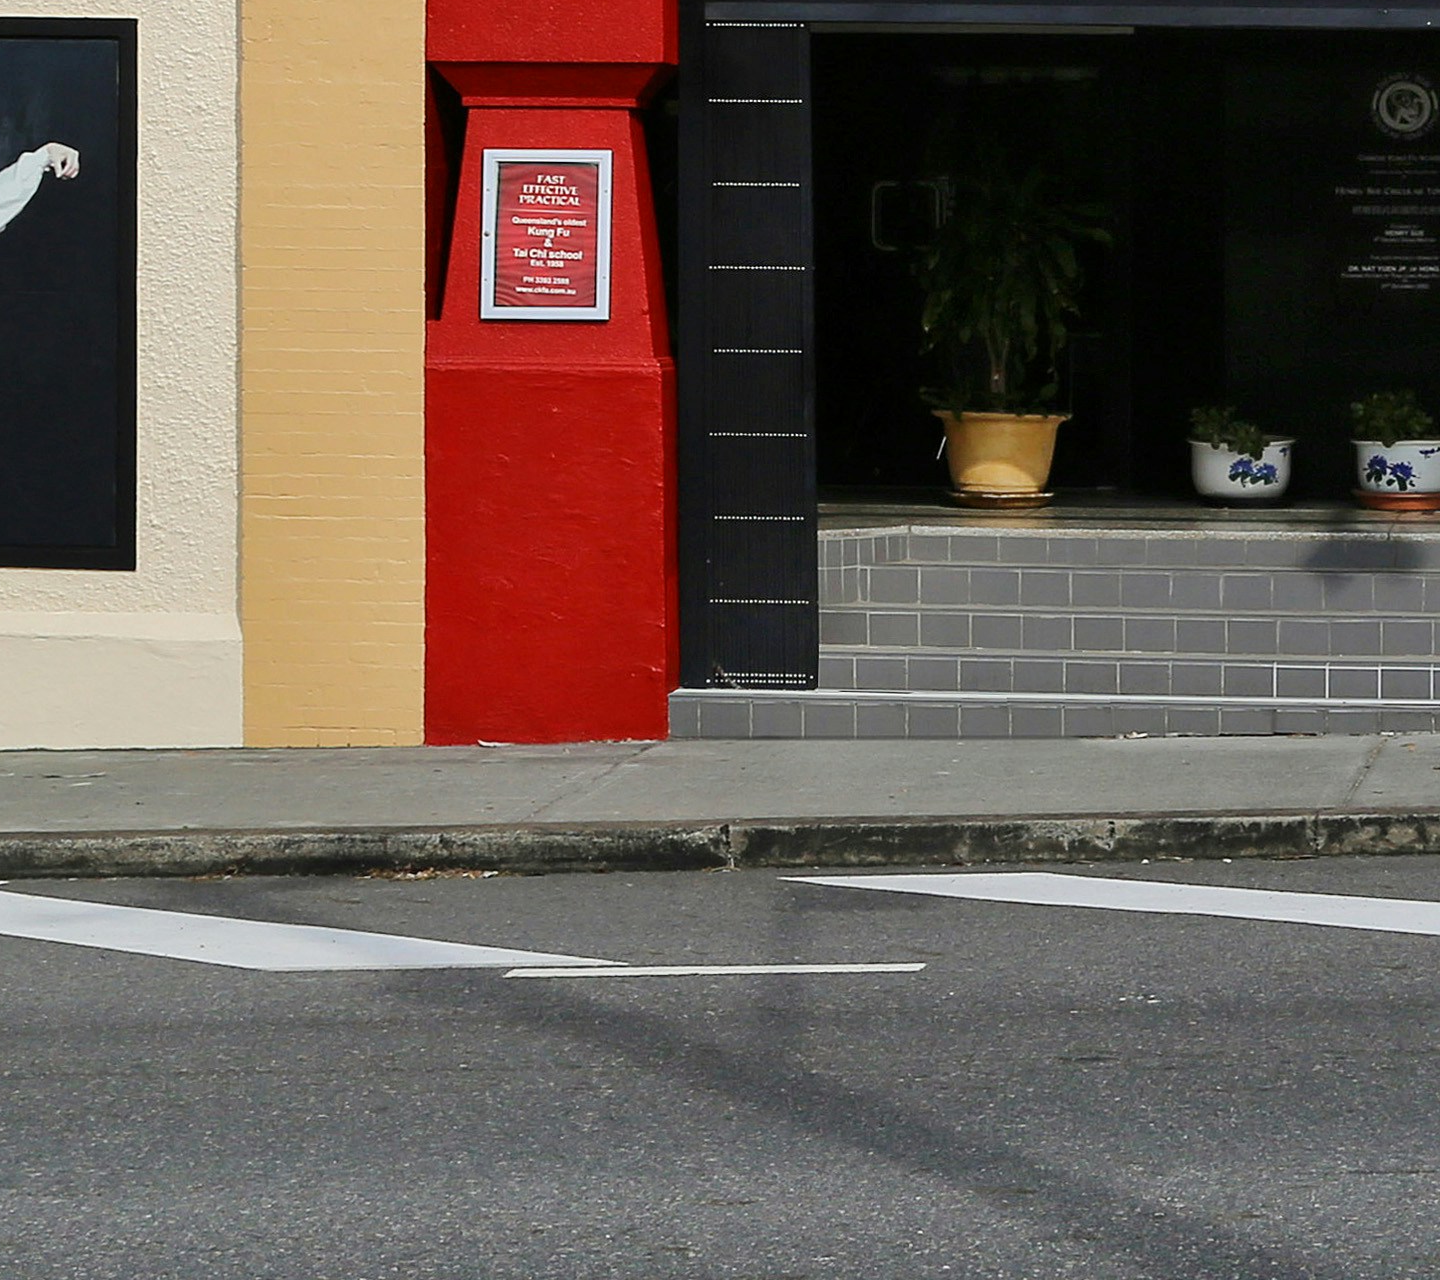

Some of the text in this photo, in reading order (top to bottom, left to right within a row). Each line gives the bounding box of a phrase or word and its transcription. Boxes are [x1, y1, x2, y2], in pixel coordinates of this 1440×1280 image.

[537, 175, 566, 185] FAST
[522, 184, 578, 196] EFFECTIVE
[519, 195, 581, 206] PRACTICAL
[512, 216, 587, 227] Queensland's oldest
[527, 226, 571, 238] Kung Fu
[543, 238, 553, 248] &
[512, 248, 583, 260] Tai Chi school
